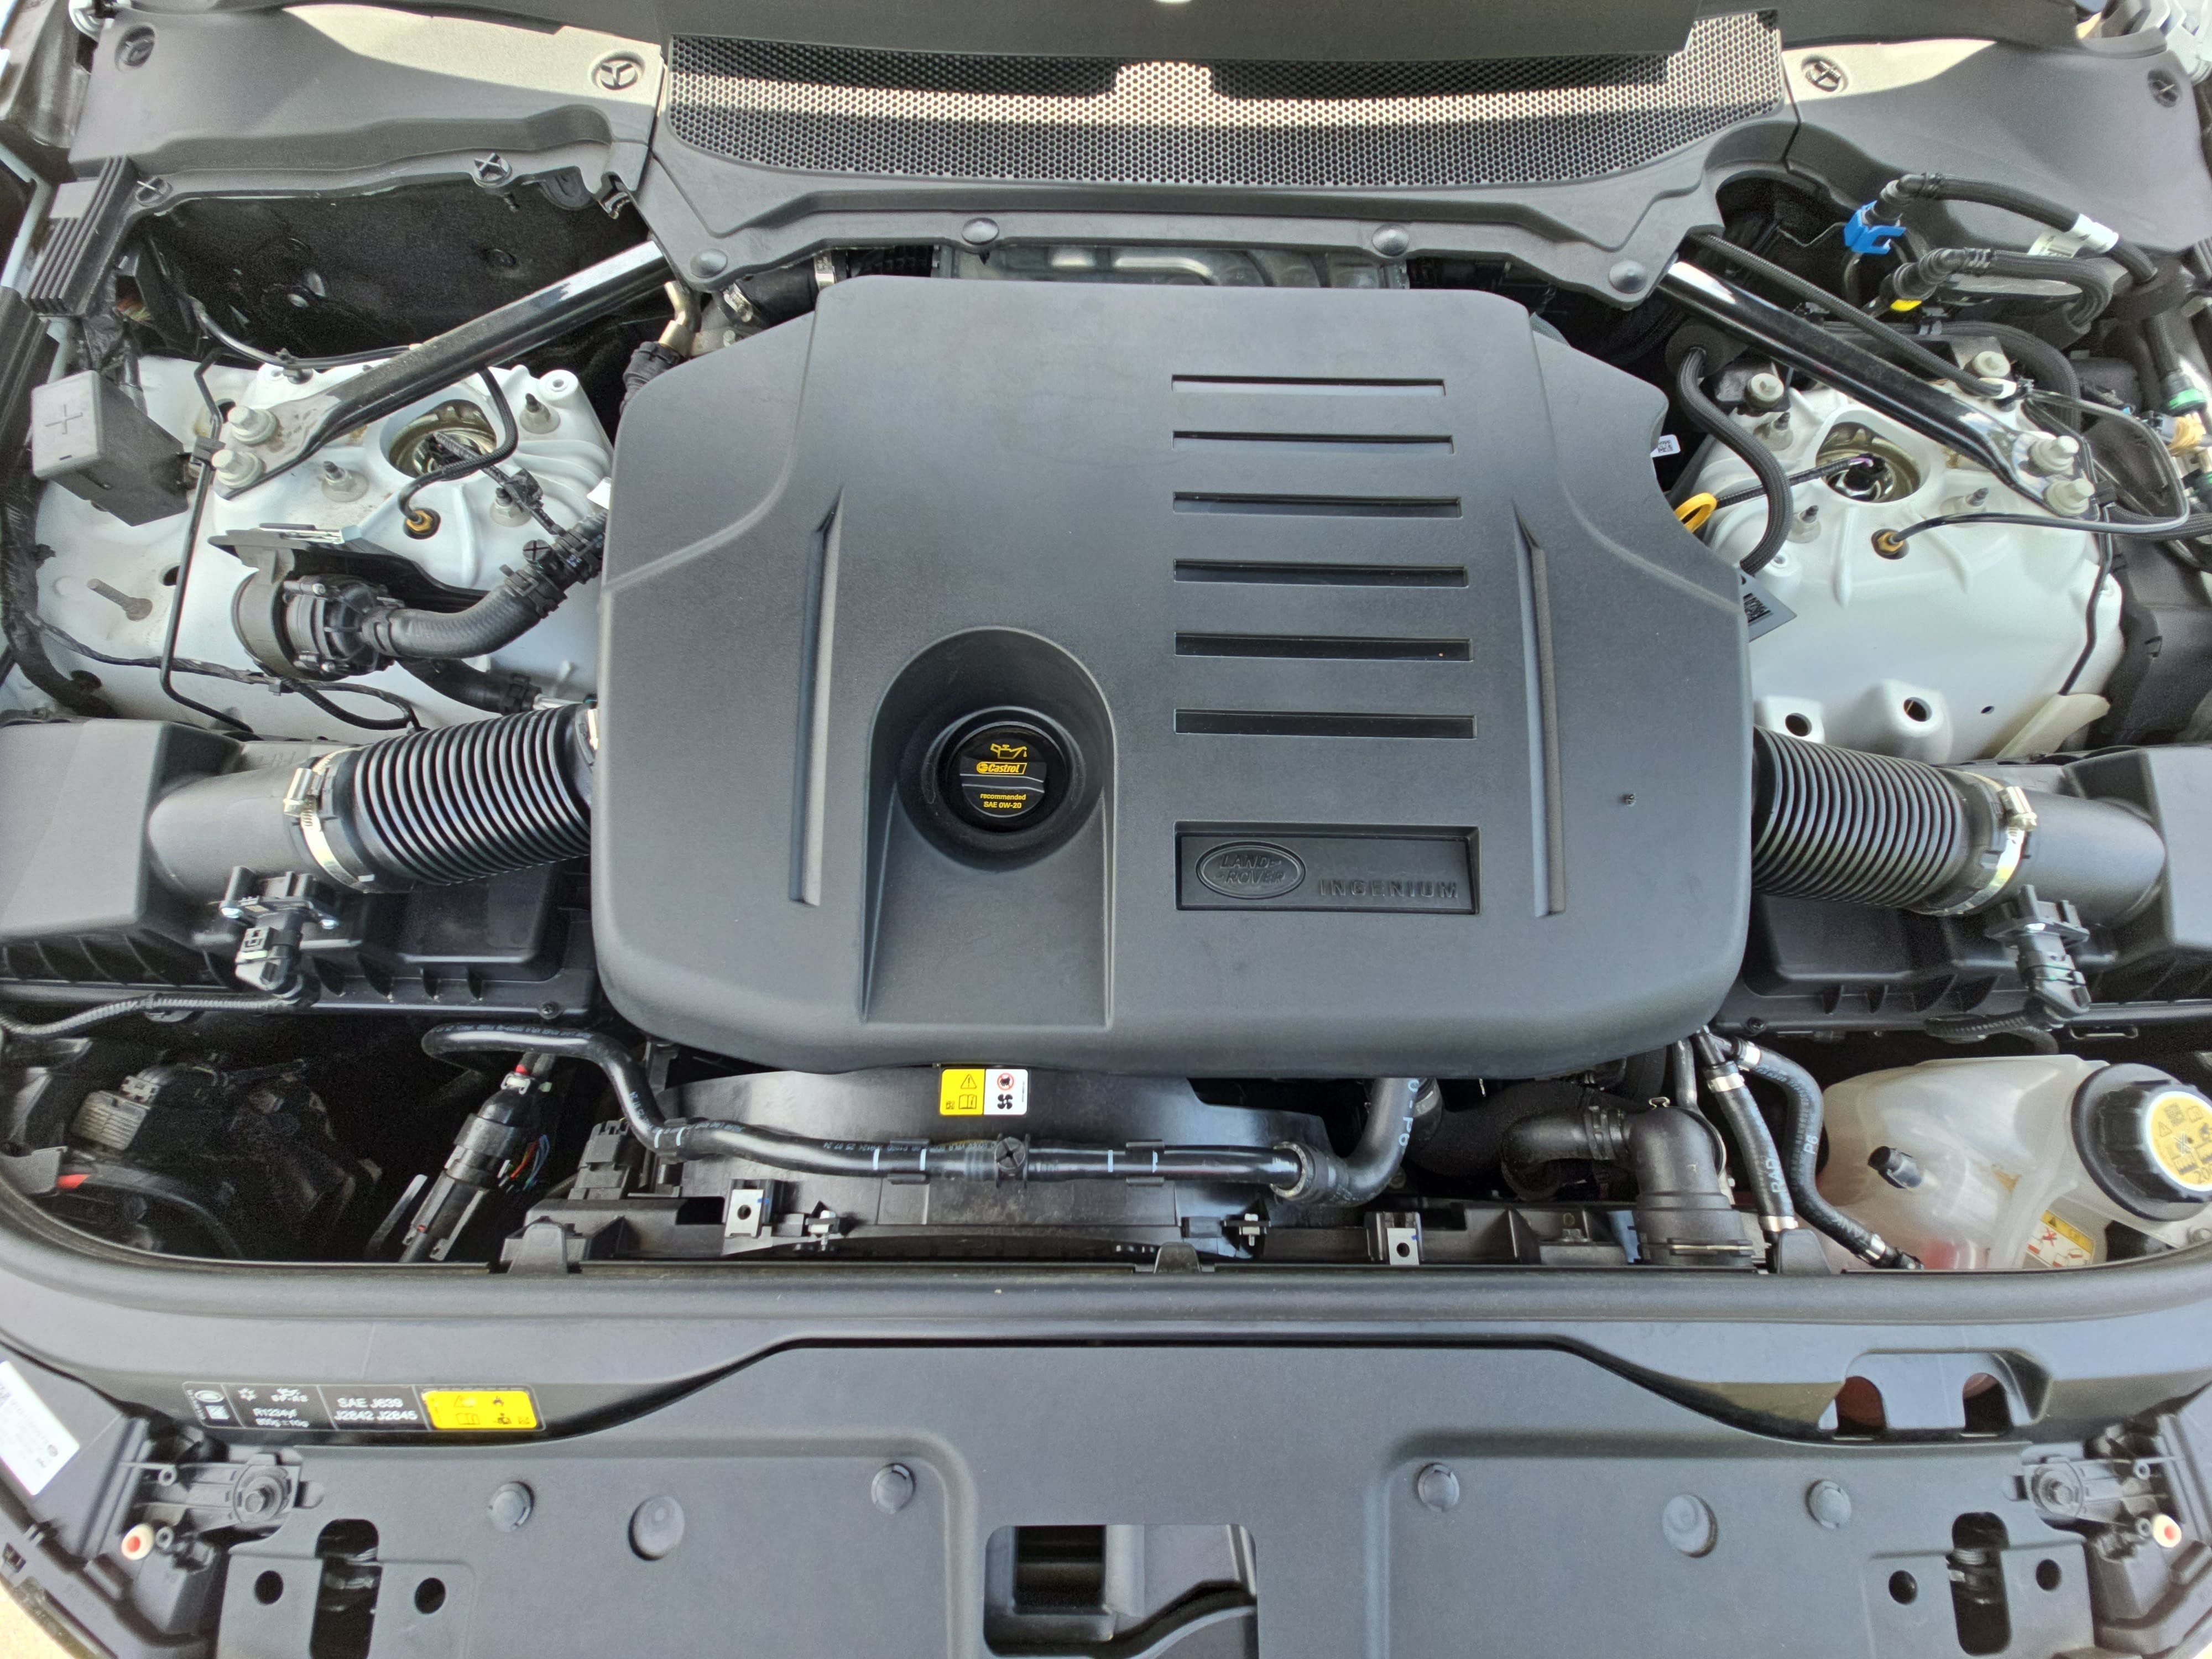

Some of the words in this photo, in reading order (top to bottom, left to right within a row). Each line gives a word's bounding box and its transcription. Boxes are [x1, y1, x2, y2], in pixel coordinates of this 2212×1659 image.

[988, 763, 1020, 773] Castrol
[1220, 853, 1269, 868] LAND
[1224, 869, 1285, 884] ROVER
[1318, 879, 1458, 898] INGENIUM
[1803, 1134, 1818, 1155] P6
[1765, 1157, 1787, 1193] RAD
[337, 1397, 368, 1408] SAE
[370, 1398, 404, 1408] J639
[333, 1411, 375, 1421] J2842
